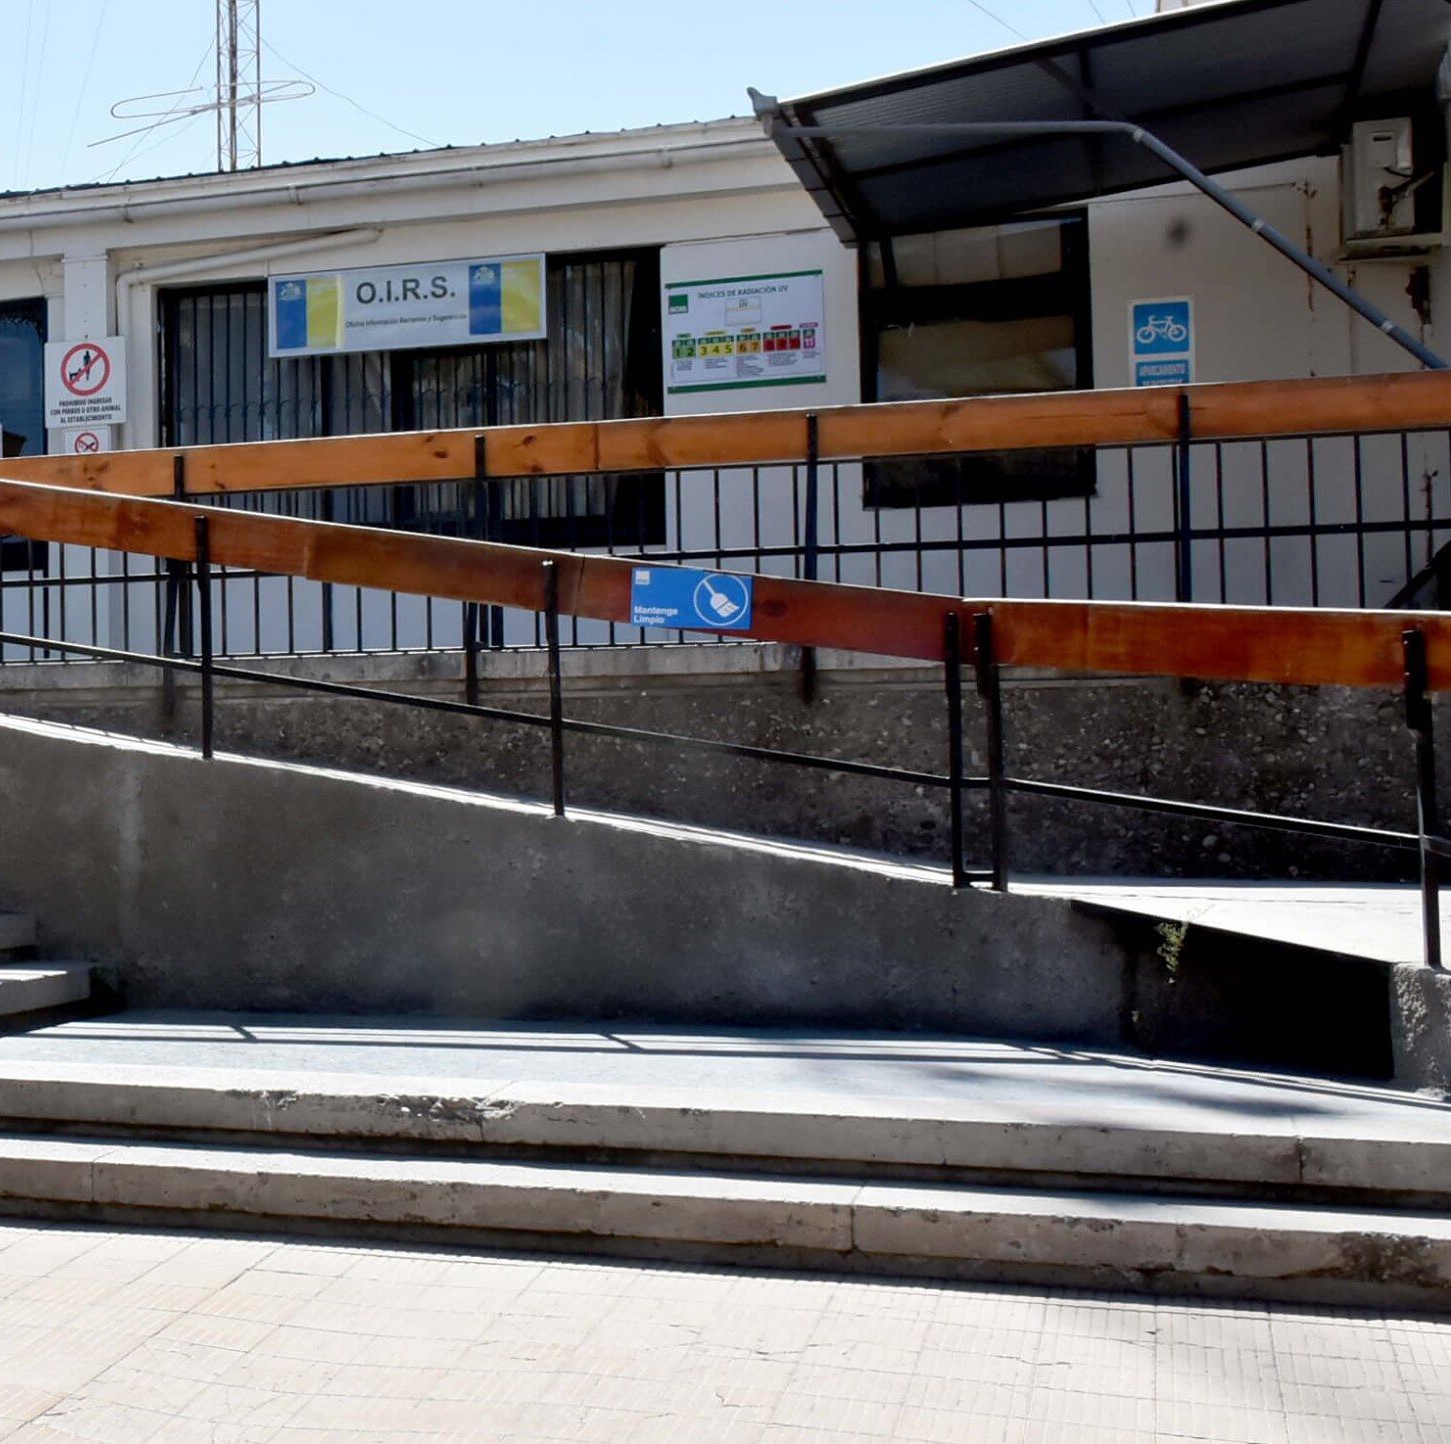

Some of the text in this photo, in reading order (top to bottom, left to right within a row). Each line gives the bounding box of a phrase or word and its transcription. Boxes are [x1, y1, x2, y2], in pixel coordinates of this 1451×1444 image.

[356, 275, 456, 304] O.I.R.S.
[728, 289, 736, 297] DE
[778, 285, 788, 293] UV
[700, 346, 707, 356] 3
[725, 344, 732, 354] 5
[633, 615, 665, 625] Limpio
